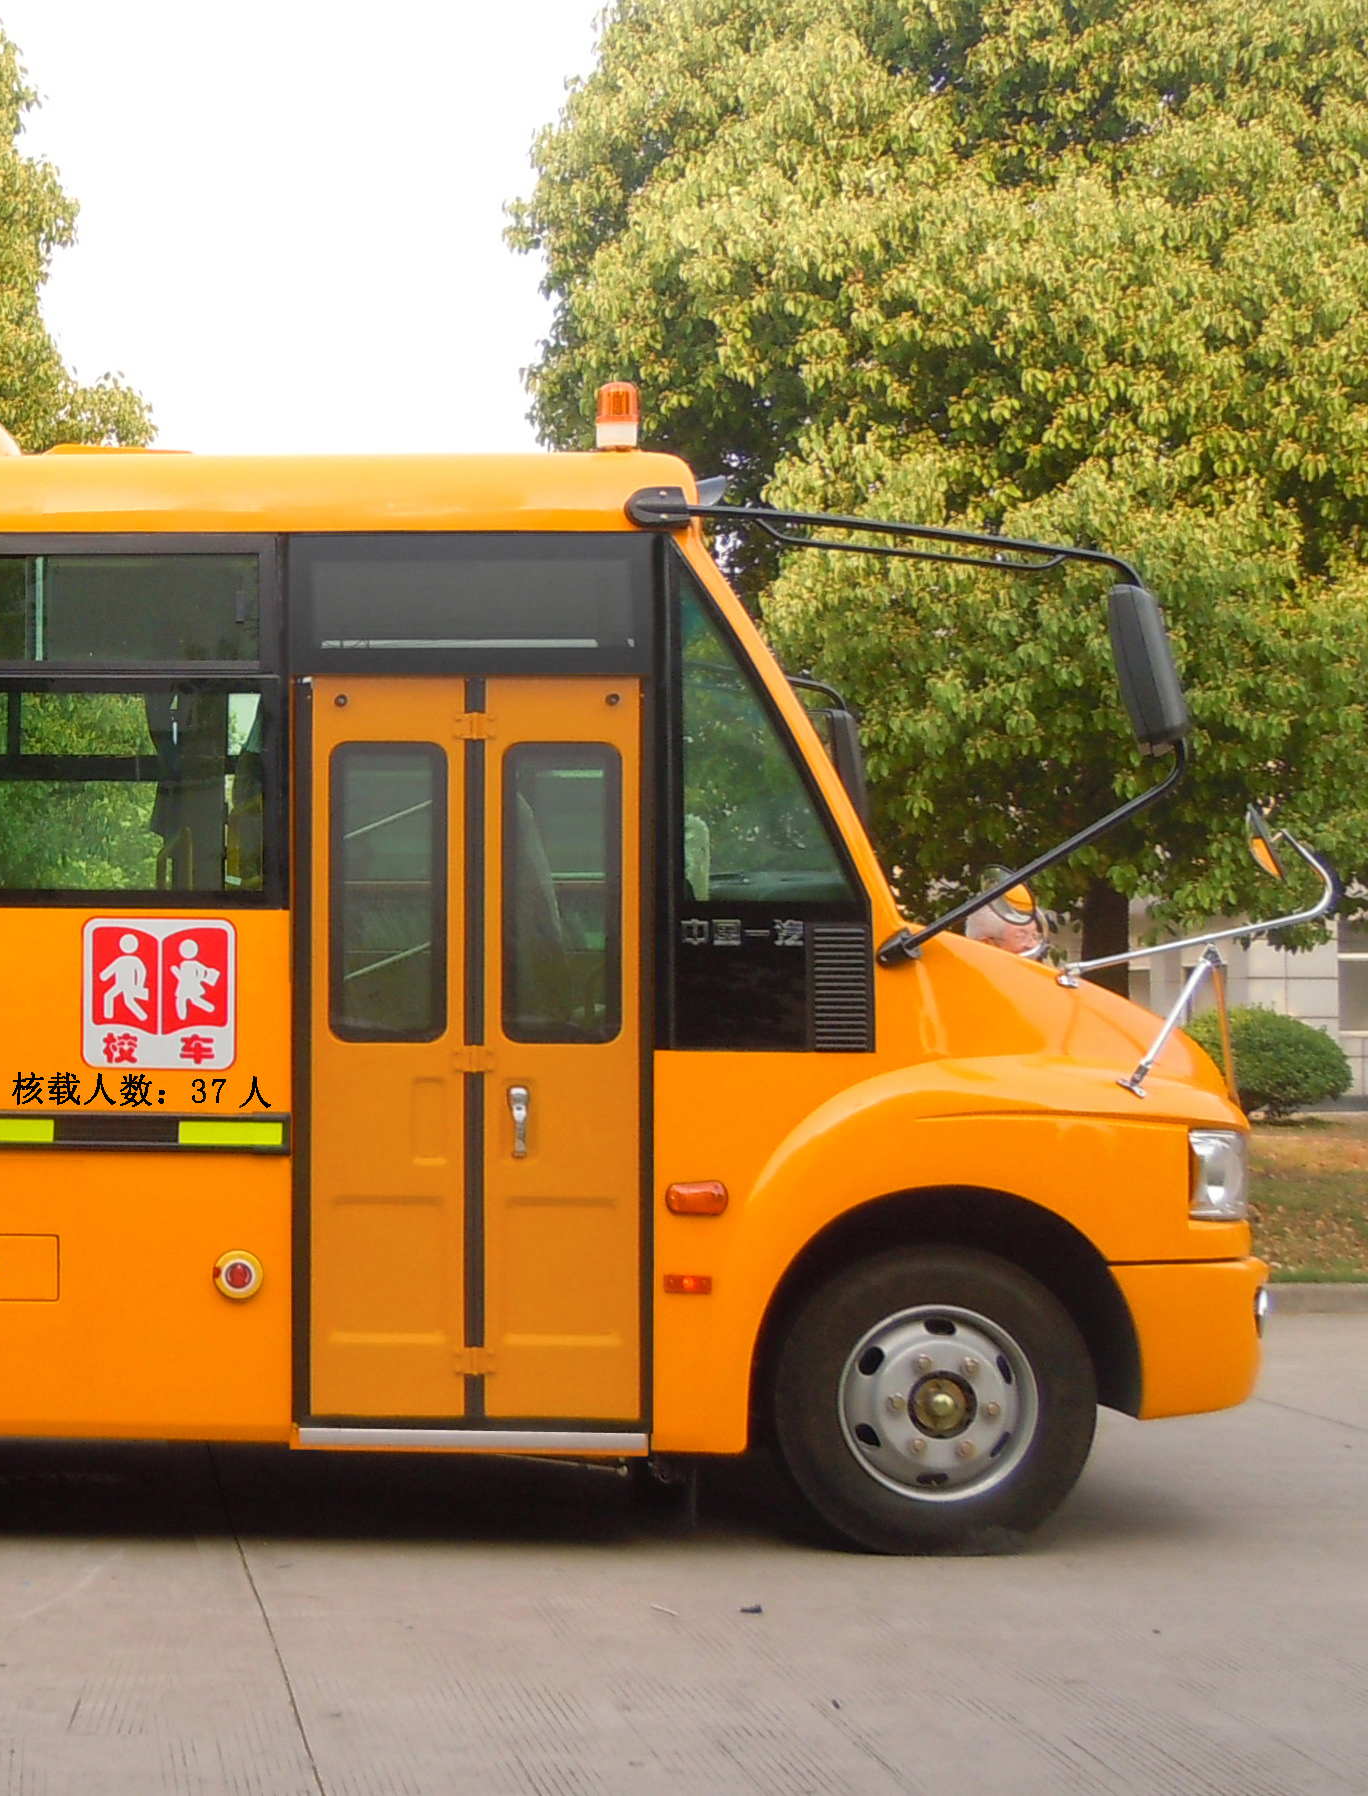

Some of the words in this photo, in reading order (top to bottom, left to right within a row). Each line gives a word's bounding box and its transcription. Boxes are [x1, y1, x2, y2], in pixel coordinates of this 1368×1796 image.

[681, 918, 804, 946] 中国一汽
[103, 1033, 215, 1065] 校车
